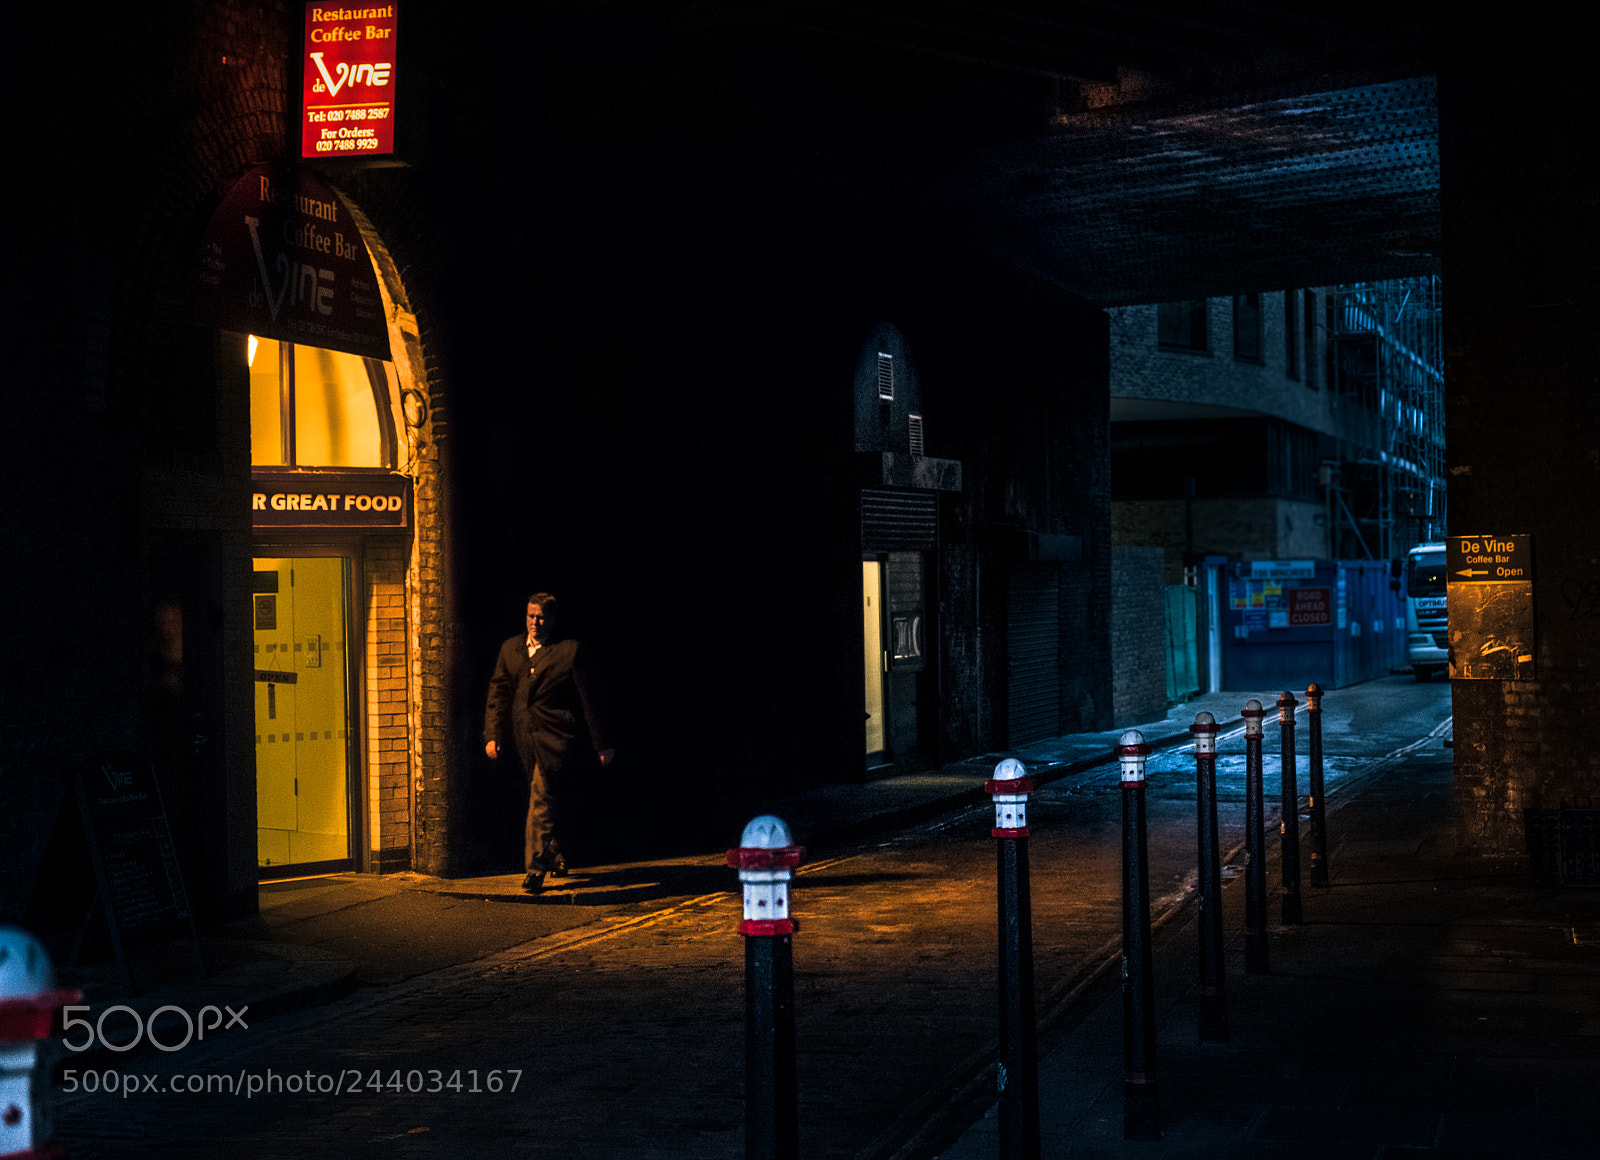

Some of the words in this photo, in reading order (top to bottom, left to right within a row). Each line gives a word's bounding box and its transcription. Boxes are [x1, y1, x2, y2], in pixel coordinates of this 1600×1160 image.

[312, 5, 393, 22] Restaurant
[310, 27, 362, 43] Coffee
[365, 25, 392, 40] Bar
[312, 78, 326, 93] de
[307, 111, 326, 122] Tel:
[327, 110, 344, 122] 020
[345, 109, 366, 120] 7488
[367, 108, 390, 119] 2587
[321, 128, 337, 139] For
[338, 127, 375, 139] Orders:
[316, 140, 333, 151] 020
[334, 139, 355, 151] 7488
[356, 138, 378, 150] 9929
[260, 175, 338, 222] Reaurant
[335, 231, 358, 261] Bar
[270, 493, 340, 511] GREAT
[344, 494, 402, 511] FOOD
[1461, 540, 1480, 553] De
[1484, 540, 1515, 553] Vine
[1466, 555, 1493, 564] Coffee
[1495, 555, 1510, 563] Bar
[1496, 566, 1523, 578] Open
[1297, 590, 1322, 600] ROAD
[1295, 601, 1325, 612] AHEAD
[1292, 612, 1328, 622] CLOSED
[260, 672, 289, 682] OPEN
